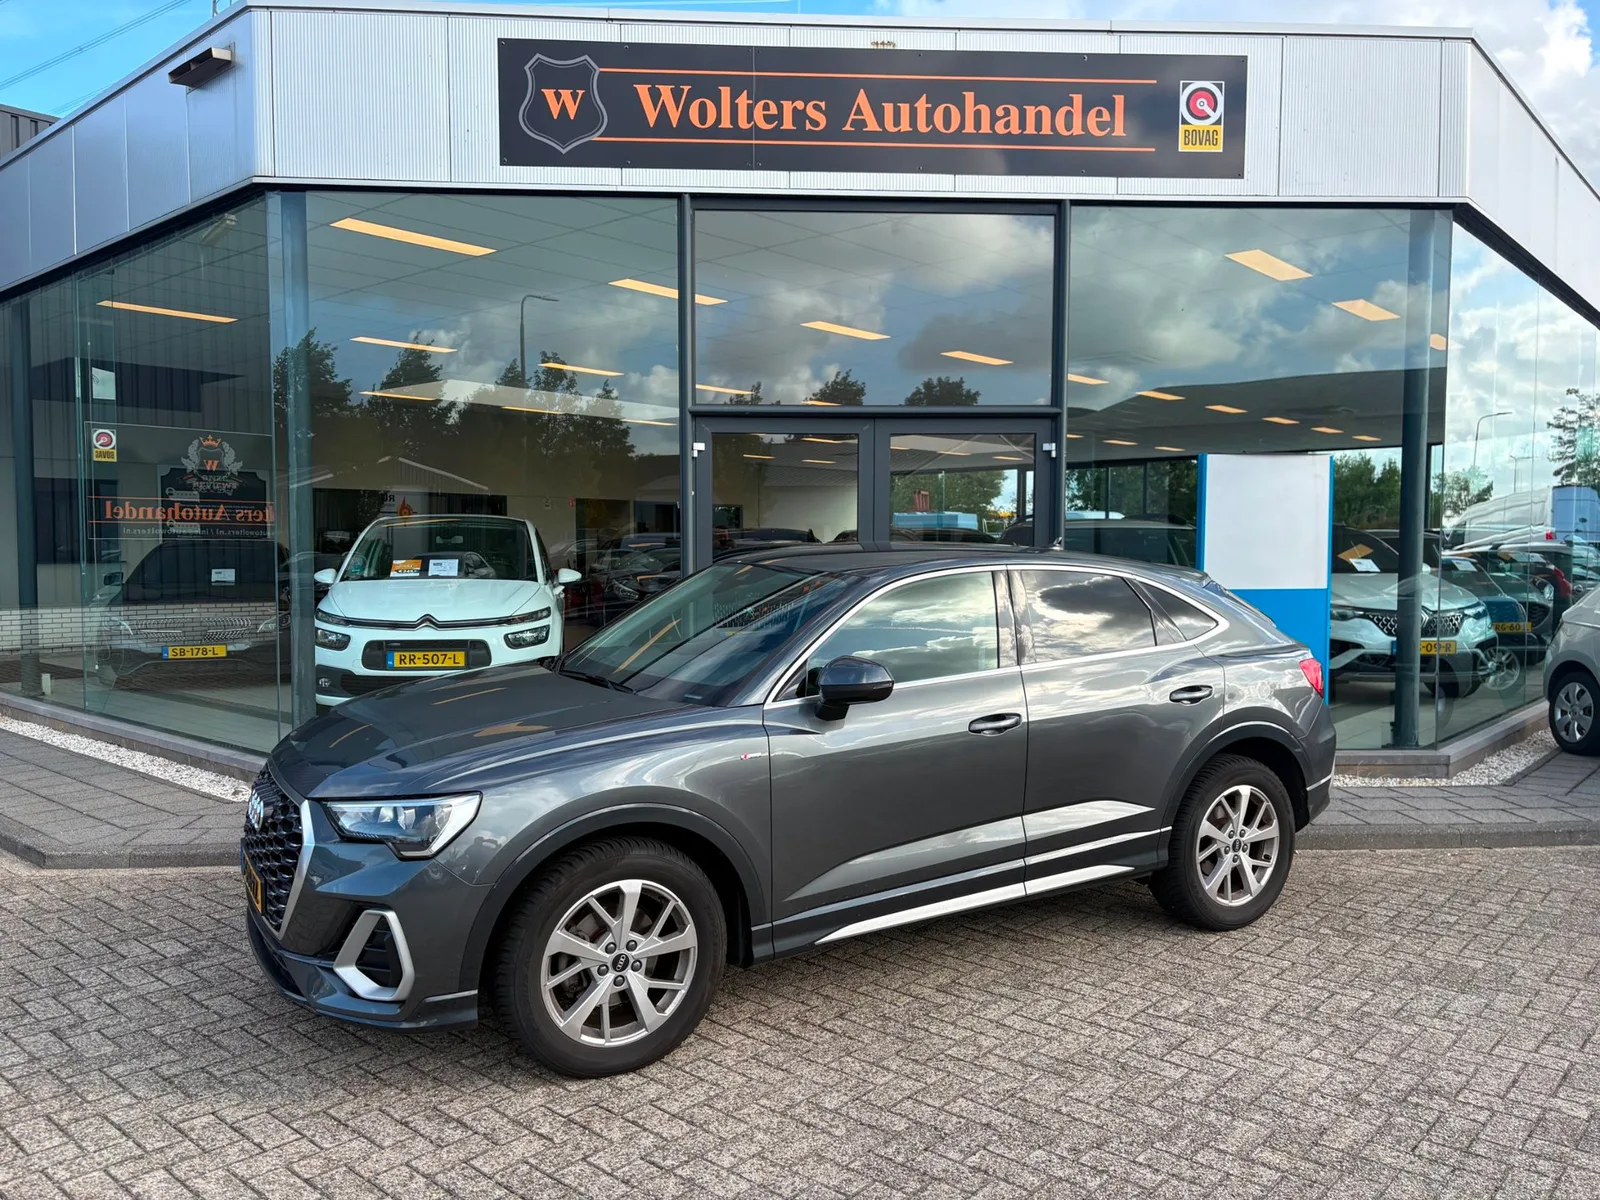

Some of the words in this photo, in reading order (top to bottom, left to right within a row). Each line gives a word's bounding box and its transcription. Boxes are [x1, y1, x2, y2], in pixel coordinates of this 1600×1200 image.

[541, 88, 585, 120] W
[633, 84, 827, 132] Wolters
[842, 88, 1127, 137] Autohandel
[1183, 128, 1219, 147] BOVAG
[172, 647, 218, 657] SB-178-L
[399, 653, 460, 665] RR-507-L
